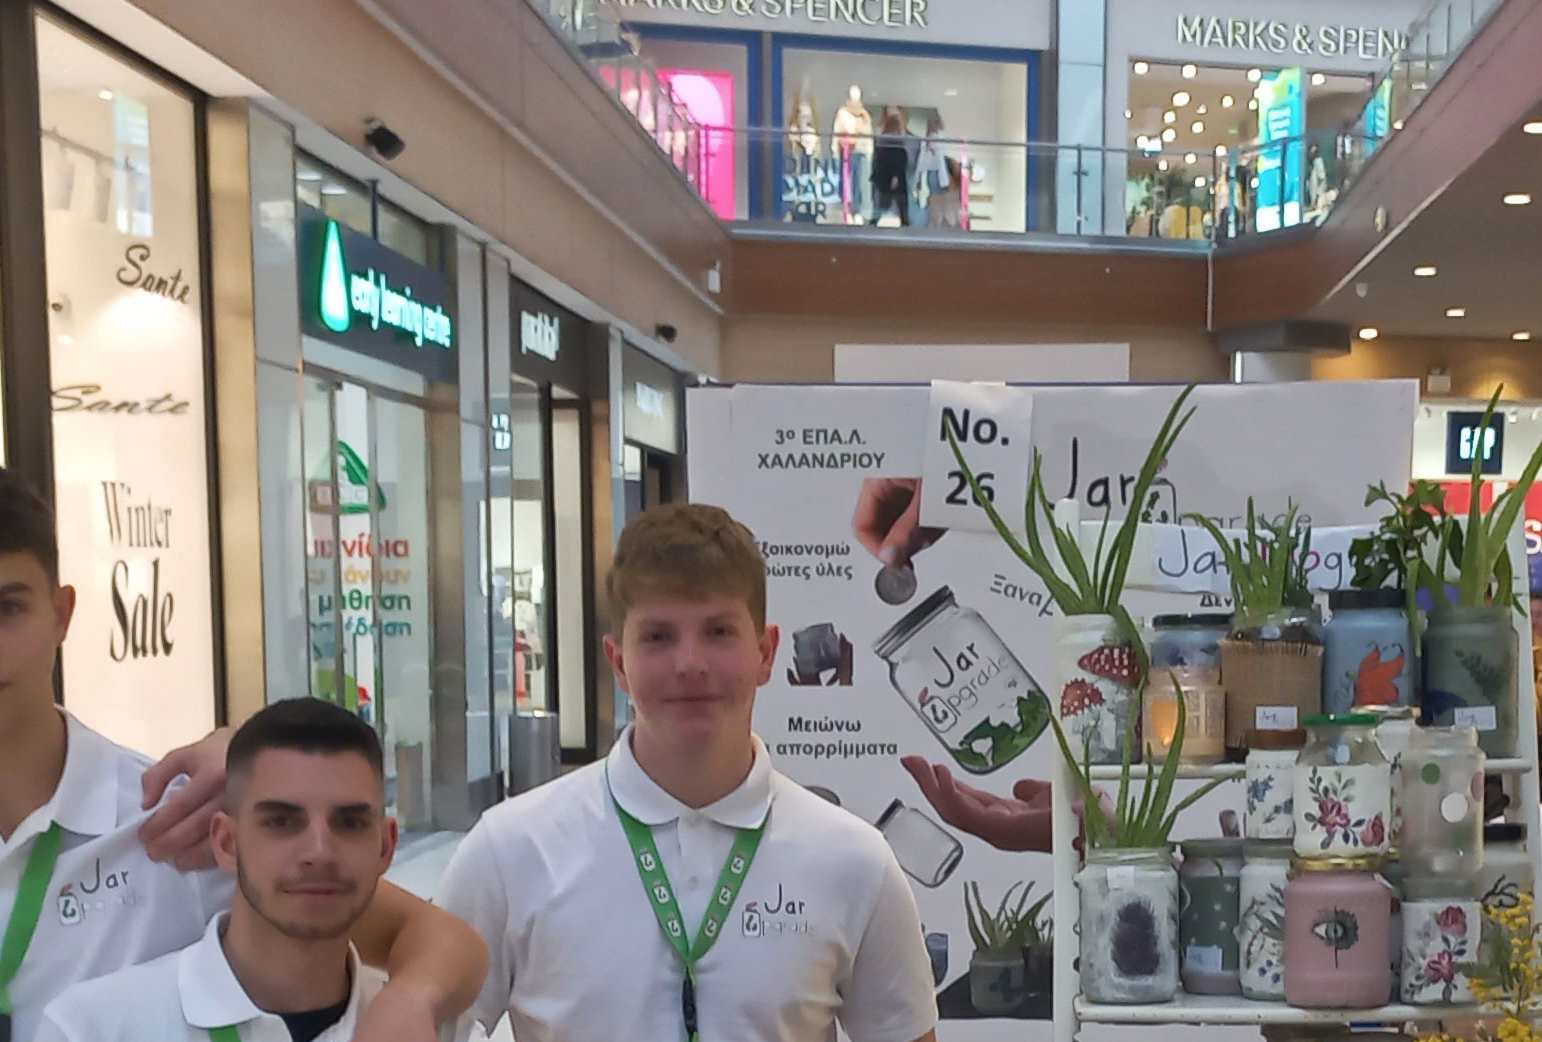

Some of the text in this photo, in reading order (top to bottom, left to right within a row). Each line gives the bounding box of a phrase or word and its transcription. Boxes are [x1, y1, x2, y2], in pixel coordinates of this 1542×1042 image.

[1176, 13, 1288, 53] MARKS
[1292, 23, 1313, 55] &
[117, 243, 190, 304] Sante
[939, 407, 1009, 447] No.
[757, 452, 886, 470] ΧΑΛΑΝΔΡΙΟΥ
[945, 470, 996, 508] 26
[100, 480, 172, 549] Winter
[109, 557, 175, 664] Sale
[932, 642, 979, 689] Jar
[787, 715, 862, 734] Μειώνω
[776, 741, 899, 760] απορρίμματα
[80, 857, 129, 894] Jar
[764, 882, 806, 915] Jar
